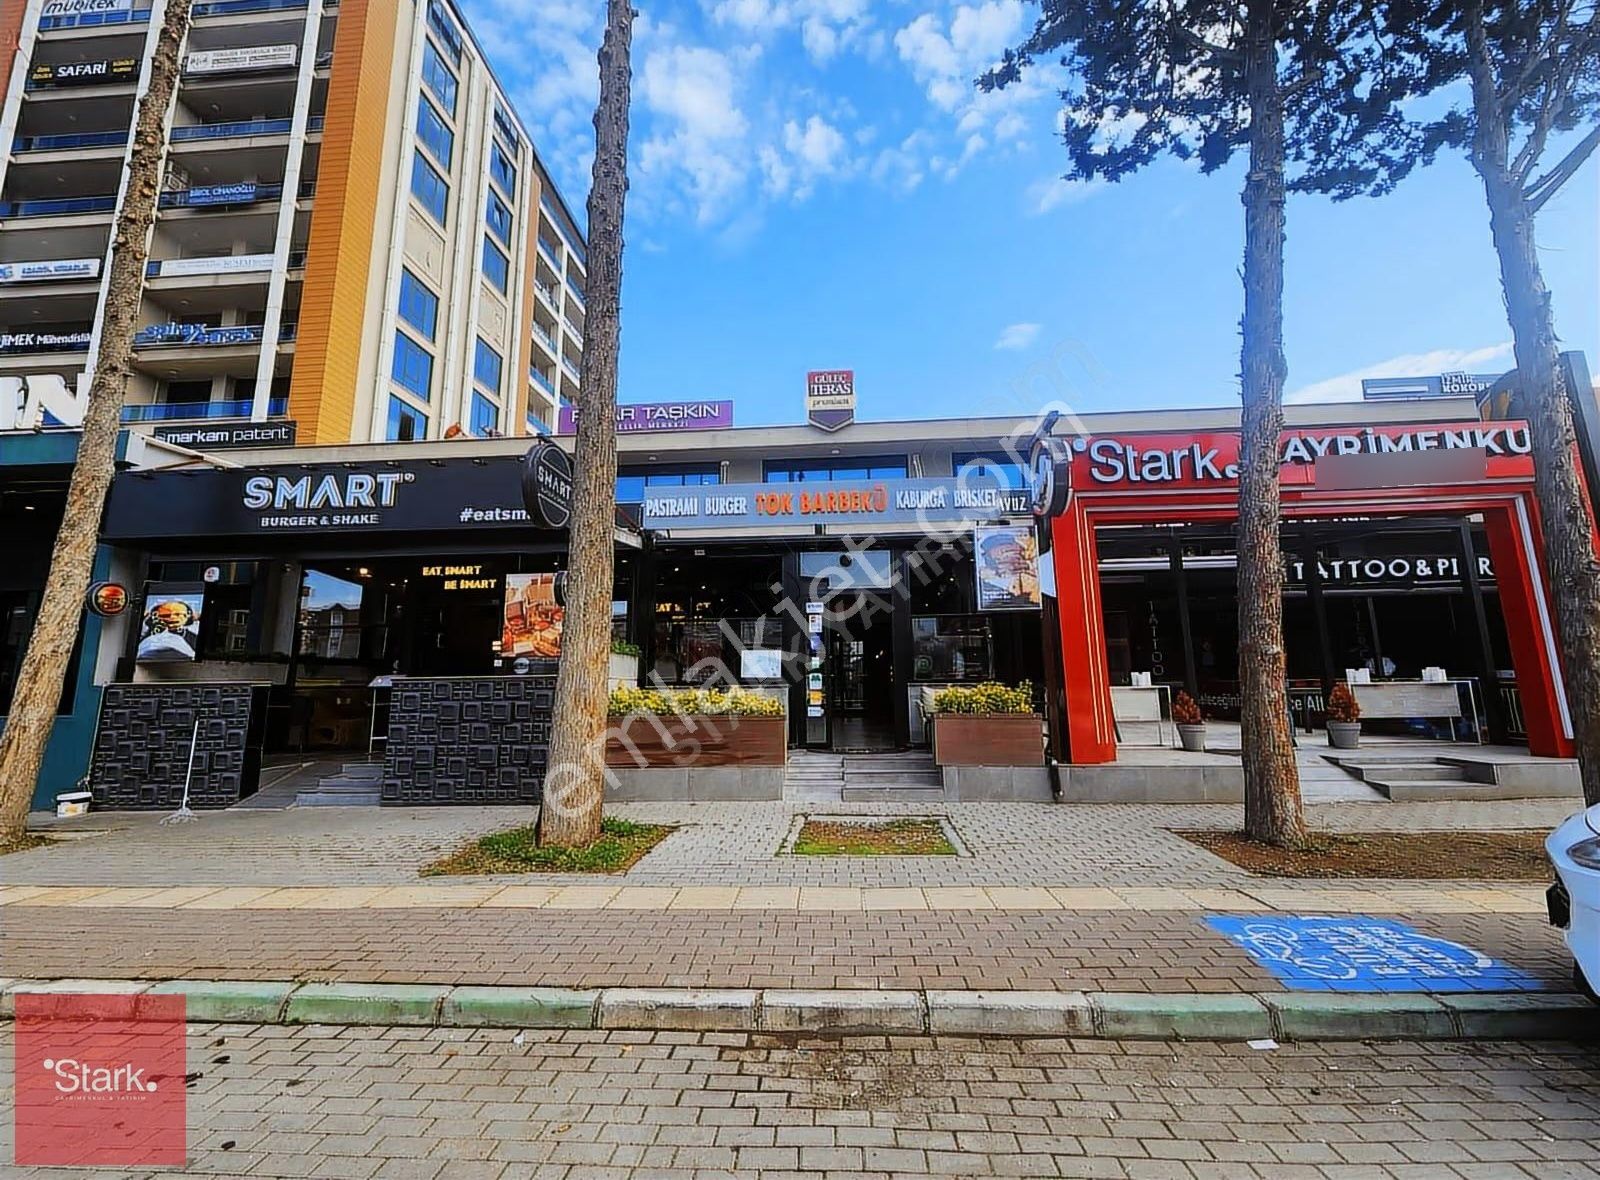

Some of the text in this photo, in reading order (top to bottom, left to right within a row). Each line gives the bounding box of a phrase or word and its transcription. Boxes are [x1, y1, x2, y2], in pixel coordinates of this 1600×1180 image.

[641, 403, 720, 422] TAŞKIN
[167, 427, 289, 443] markam patent
[538, 465, 572, 500] SMART
[243, 473, 402, 510] SMART
[646, 484, 997, 517] PASTRAMI BURGER TOK BARBEKÜ KABURGA BRISKET
[261, 514, 379, 527] BURGER & SHAKE
[459, 507, 531, 522] #eatsm
[422, 566, 443, 576] EAT
[444, 580, 457, 590] BE
